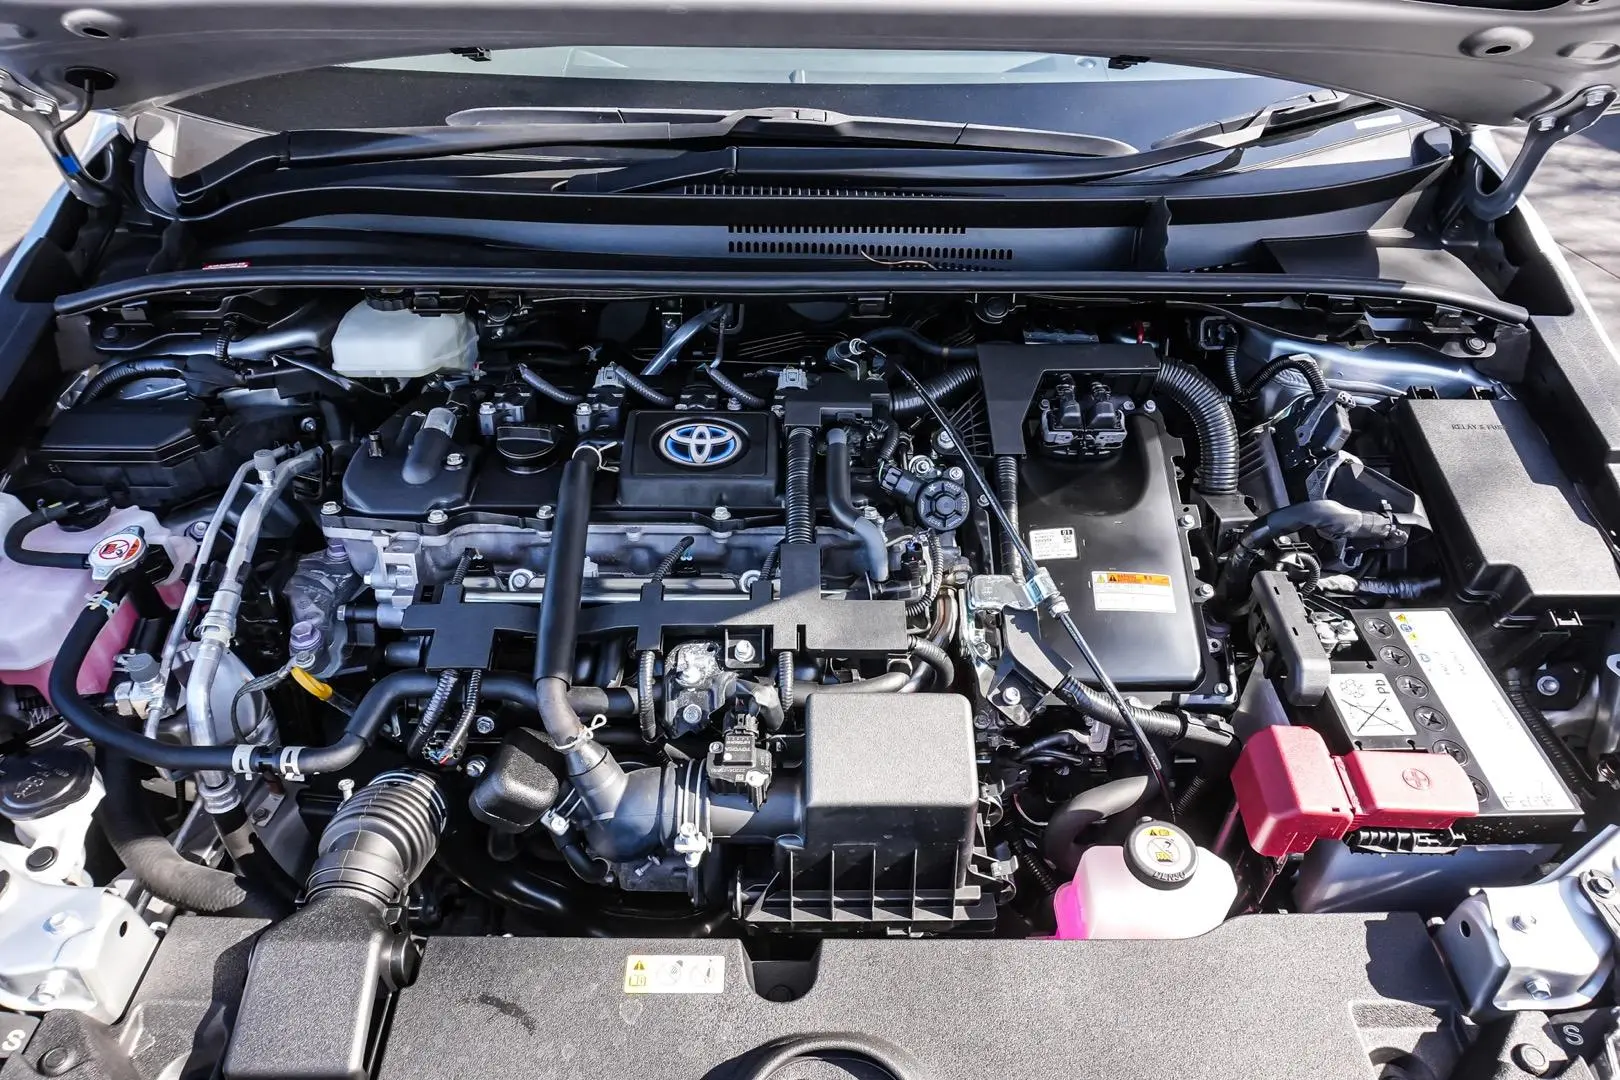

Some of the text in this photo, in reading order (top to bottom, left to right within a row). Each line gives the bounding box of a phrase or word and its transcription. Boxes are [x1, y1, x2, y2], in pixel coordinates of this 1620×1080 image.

[1375, 679, 1391, 694] Pb
[1153, 871, 1186, 881] DENSO
[1, 1029, 26, 1051] S
[1562, 1024, 1584, 1046] S
